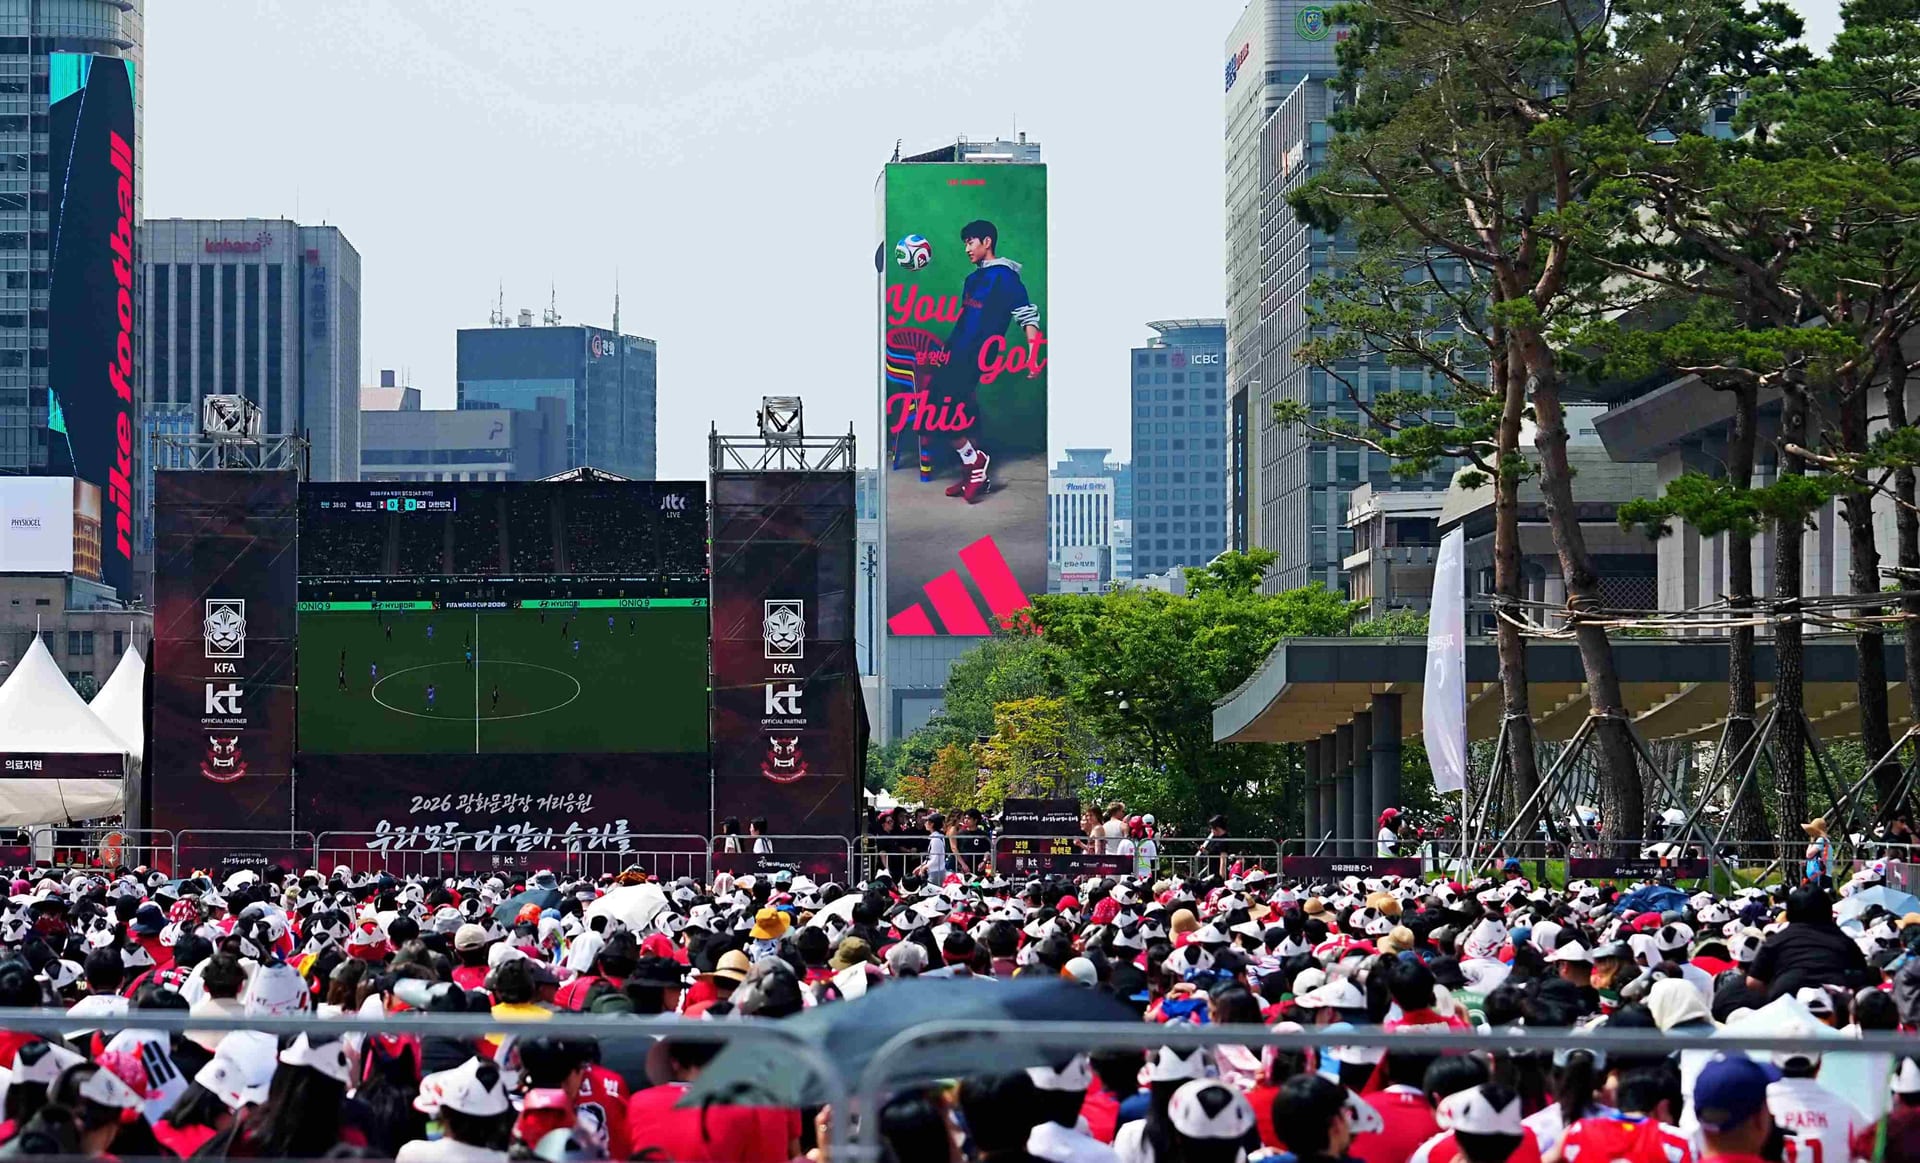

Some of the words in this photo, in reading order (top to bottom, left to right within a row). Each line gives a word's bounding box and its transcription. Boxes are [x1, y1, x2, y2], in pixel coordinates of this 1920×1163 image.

[205, 237, 261, 253] kobaco
[109, 131, 133, 402] football
[886, 283, 964, 326] You
[977, 330, 1048, 385] Got
[1191, 354, 1219, 365] ICBC
[886, 389, 975, 435] This
[109, 411, 131, 560] nike
[332, 501, 347, 509] 38:02
[355, 501, 373, 509] 멕시코
[390, 501, 396, 509] 0
[408, 501, 414, 509] 0
[428, 501, 452, 509] 대한민국
[666, 511, 681, 519] LIVE
[11, 519, 41, 527] PHYSIOGEL
[297, 602, 324, 610] IONIQ
[619, 600, 644, 608] IONIQ
[644, 600, 650, 608] 9
[214, 662, 236, 673] KFA
[773, 663, 796, 674] KFA
[205, 683, 243, 714] kt
[765, 684, 803, 715] kt
[5, 760, 42, 771] 의료지원
[409, 794, 452, 814] 2026
[455, 793, 533, 814] 광화문광장
[537, 793, 595, 814] 거리응원
[366, 819, 420, 859] 우리
[423, 820, 472, 854] 모두
[560, 818, 637, 855] 승리를
[503, 856, 514, 865] kt
[1028, 858, 1038, 866] kt
[1361, 864, 1373, 872] C-1
[1784, 1111, 1828, 1128] PARK
